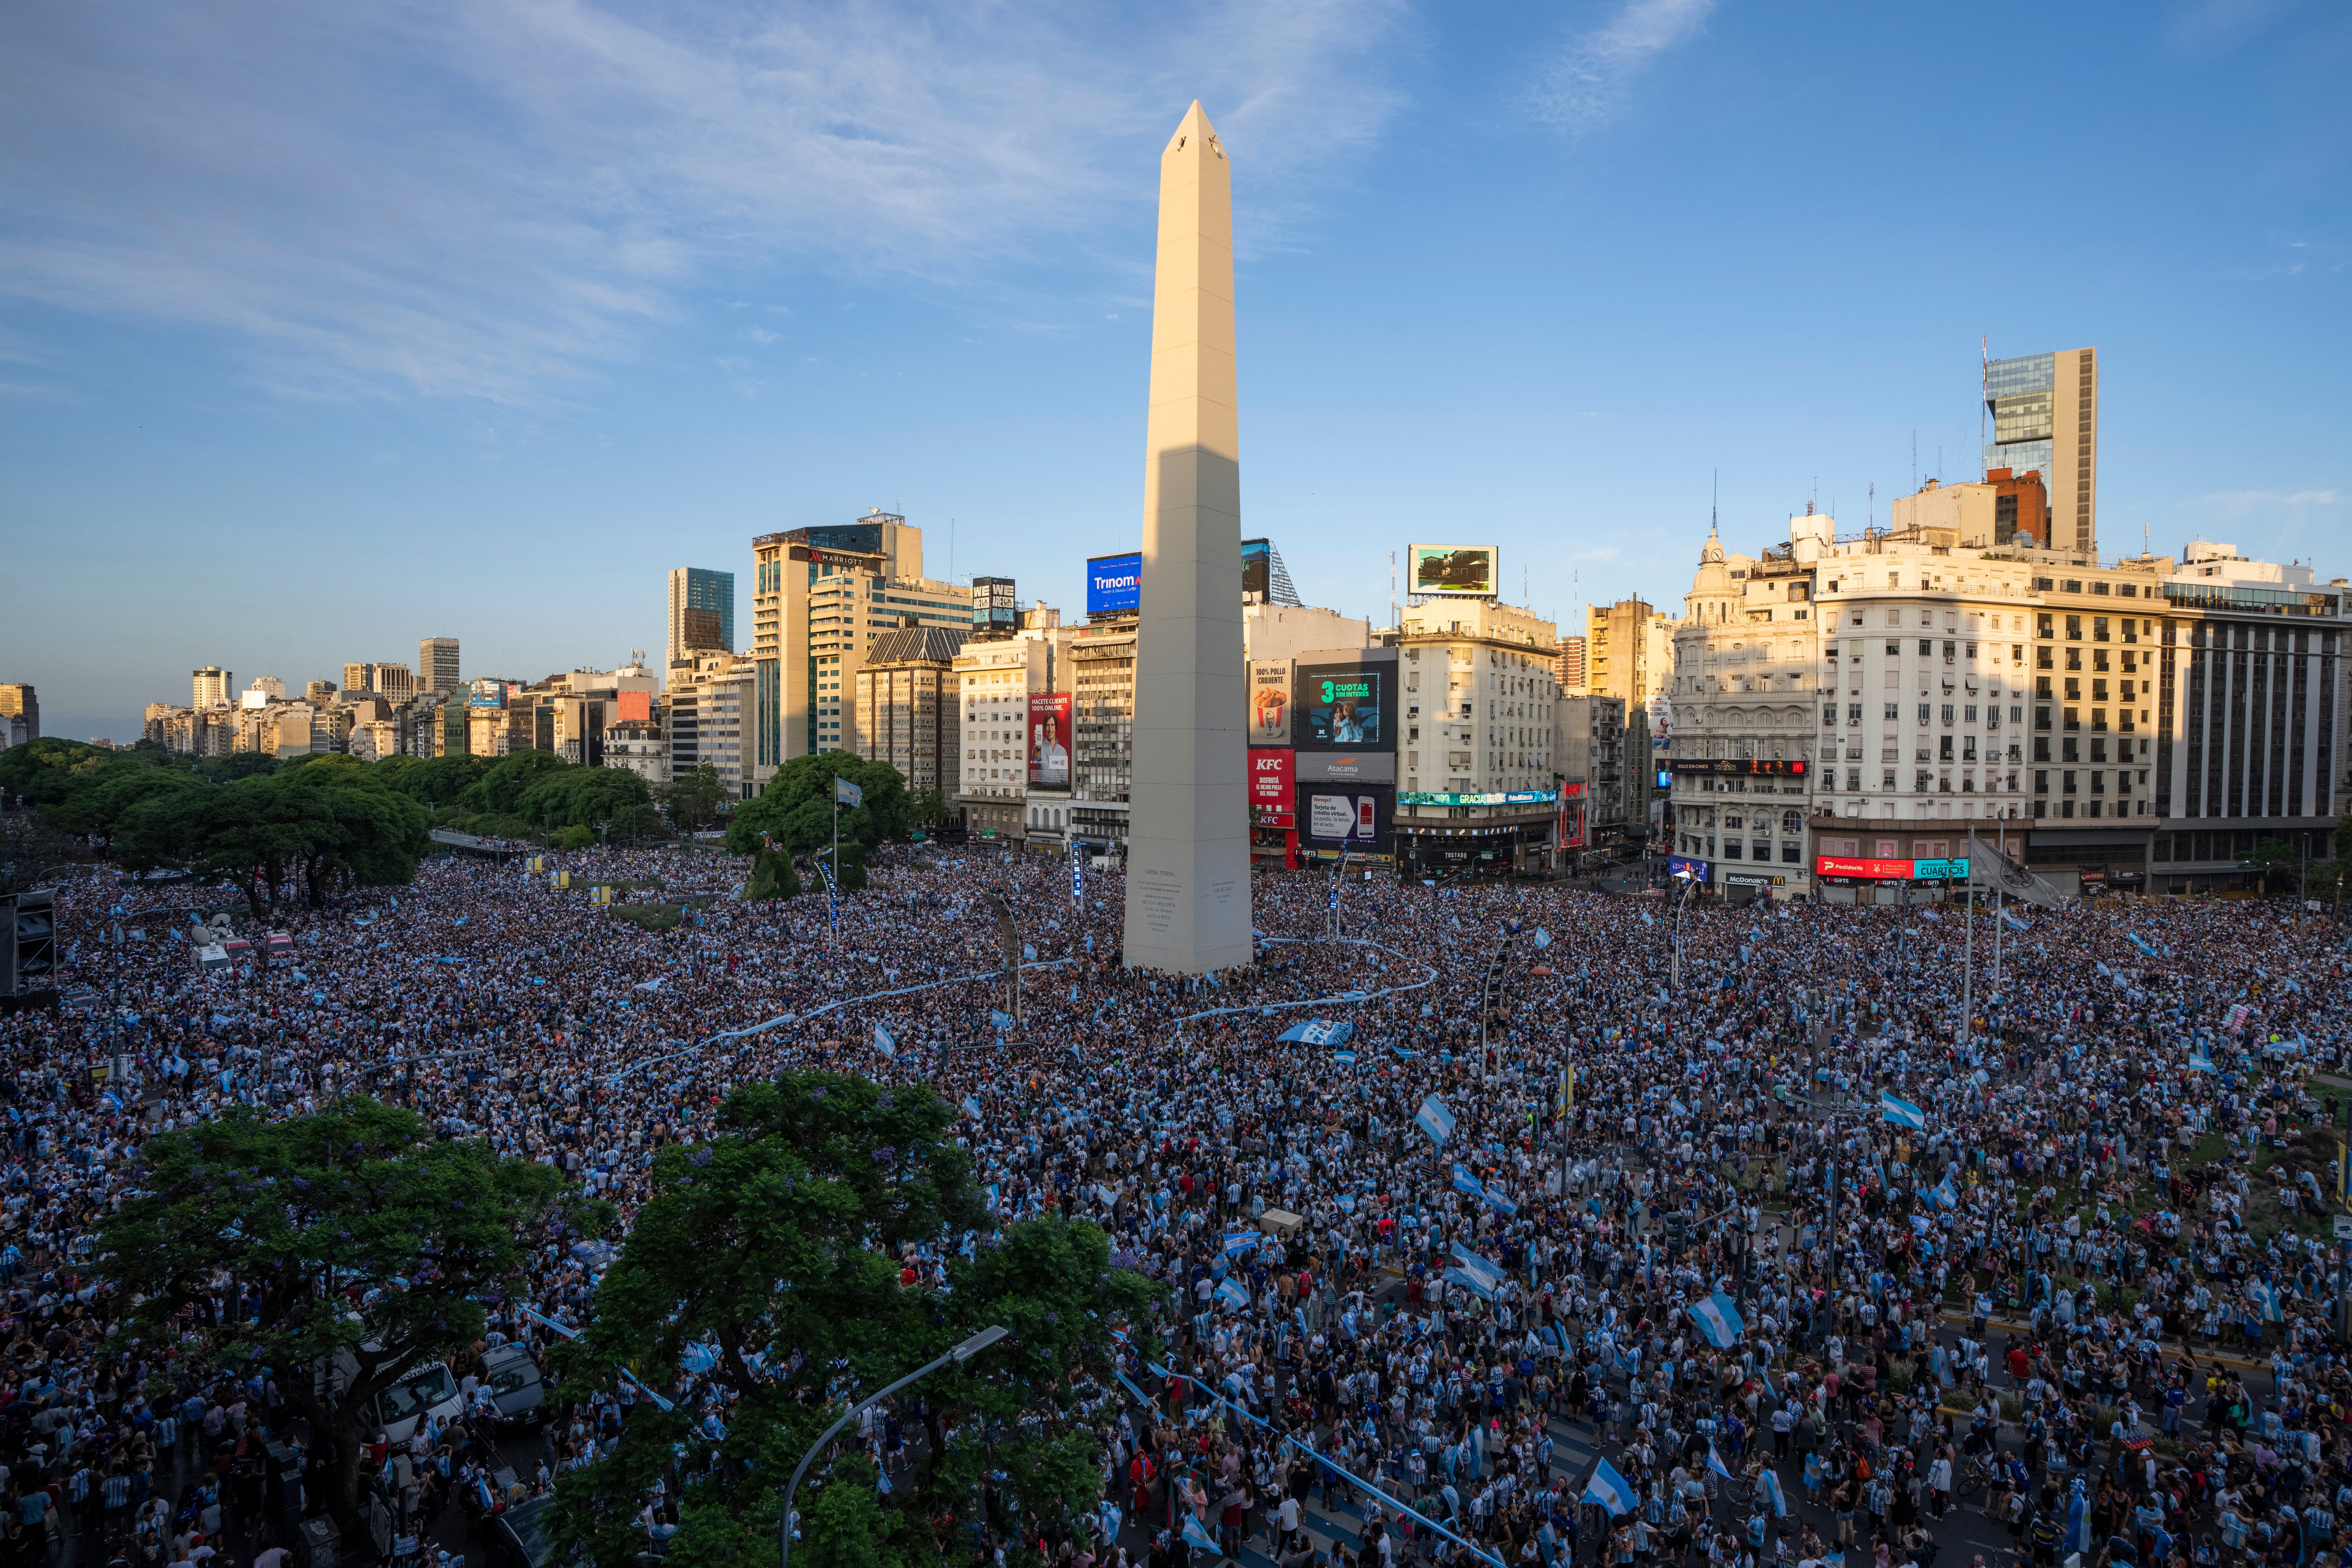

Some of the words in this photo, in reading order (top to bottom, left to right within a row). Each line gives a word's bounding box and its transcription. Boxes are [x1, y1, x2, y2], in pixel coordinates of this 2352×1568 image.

[822, 555, 862, 565] MARRIOTT
[973, 585, 989, 597] WE
[993, 584, 1014, 596] WE
[993, 596, 1003, 607] ARE
[973, 609, 989, 623] BACK
[992, 608, 1014, 622] BACK
[1321, 681, 1334, 703] 3
[1335, 683, 1368, 691] CUOTAS
[1346, 689, 1369, 697] INTERÉS
[1256, 759, 1282, 770] KFC
[1460, 794, 1486, 804] GRACIAS
[1487, 794, 1506, 803] ARGENTINOS
[1730, 876, 1768, 884] McDonald's
[2285, 1370, 2292, 1378] 10
[1597, 1405, 1604, 1413] 10
[1543, 1500, 1550, 1509] 10
